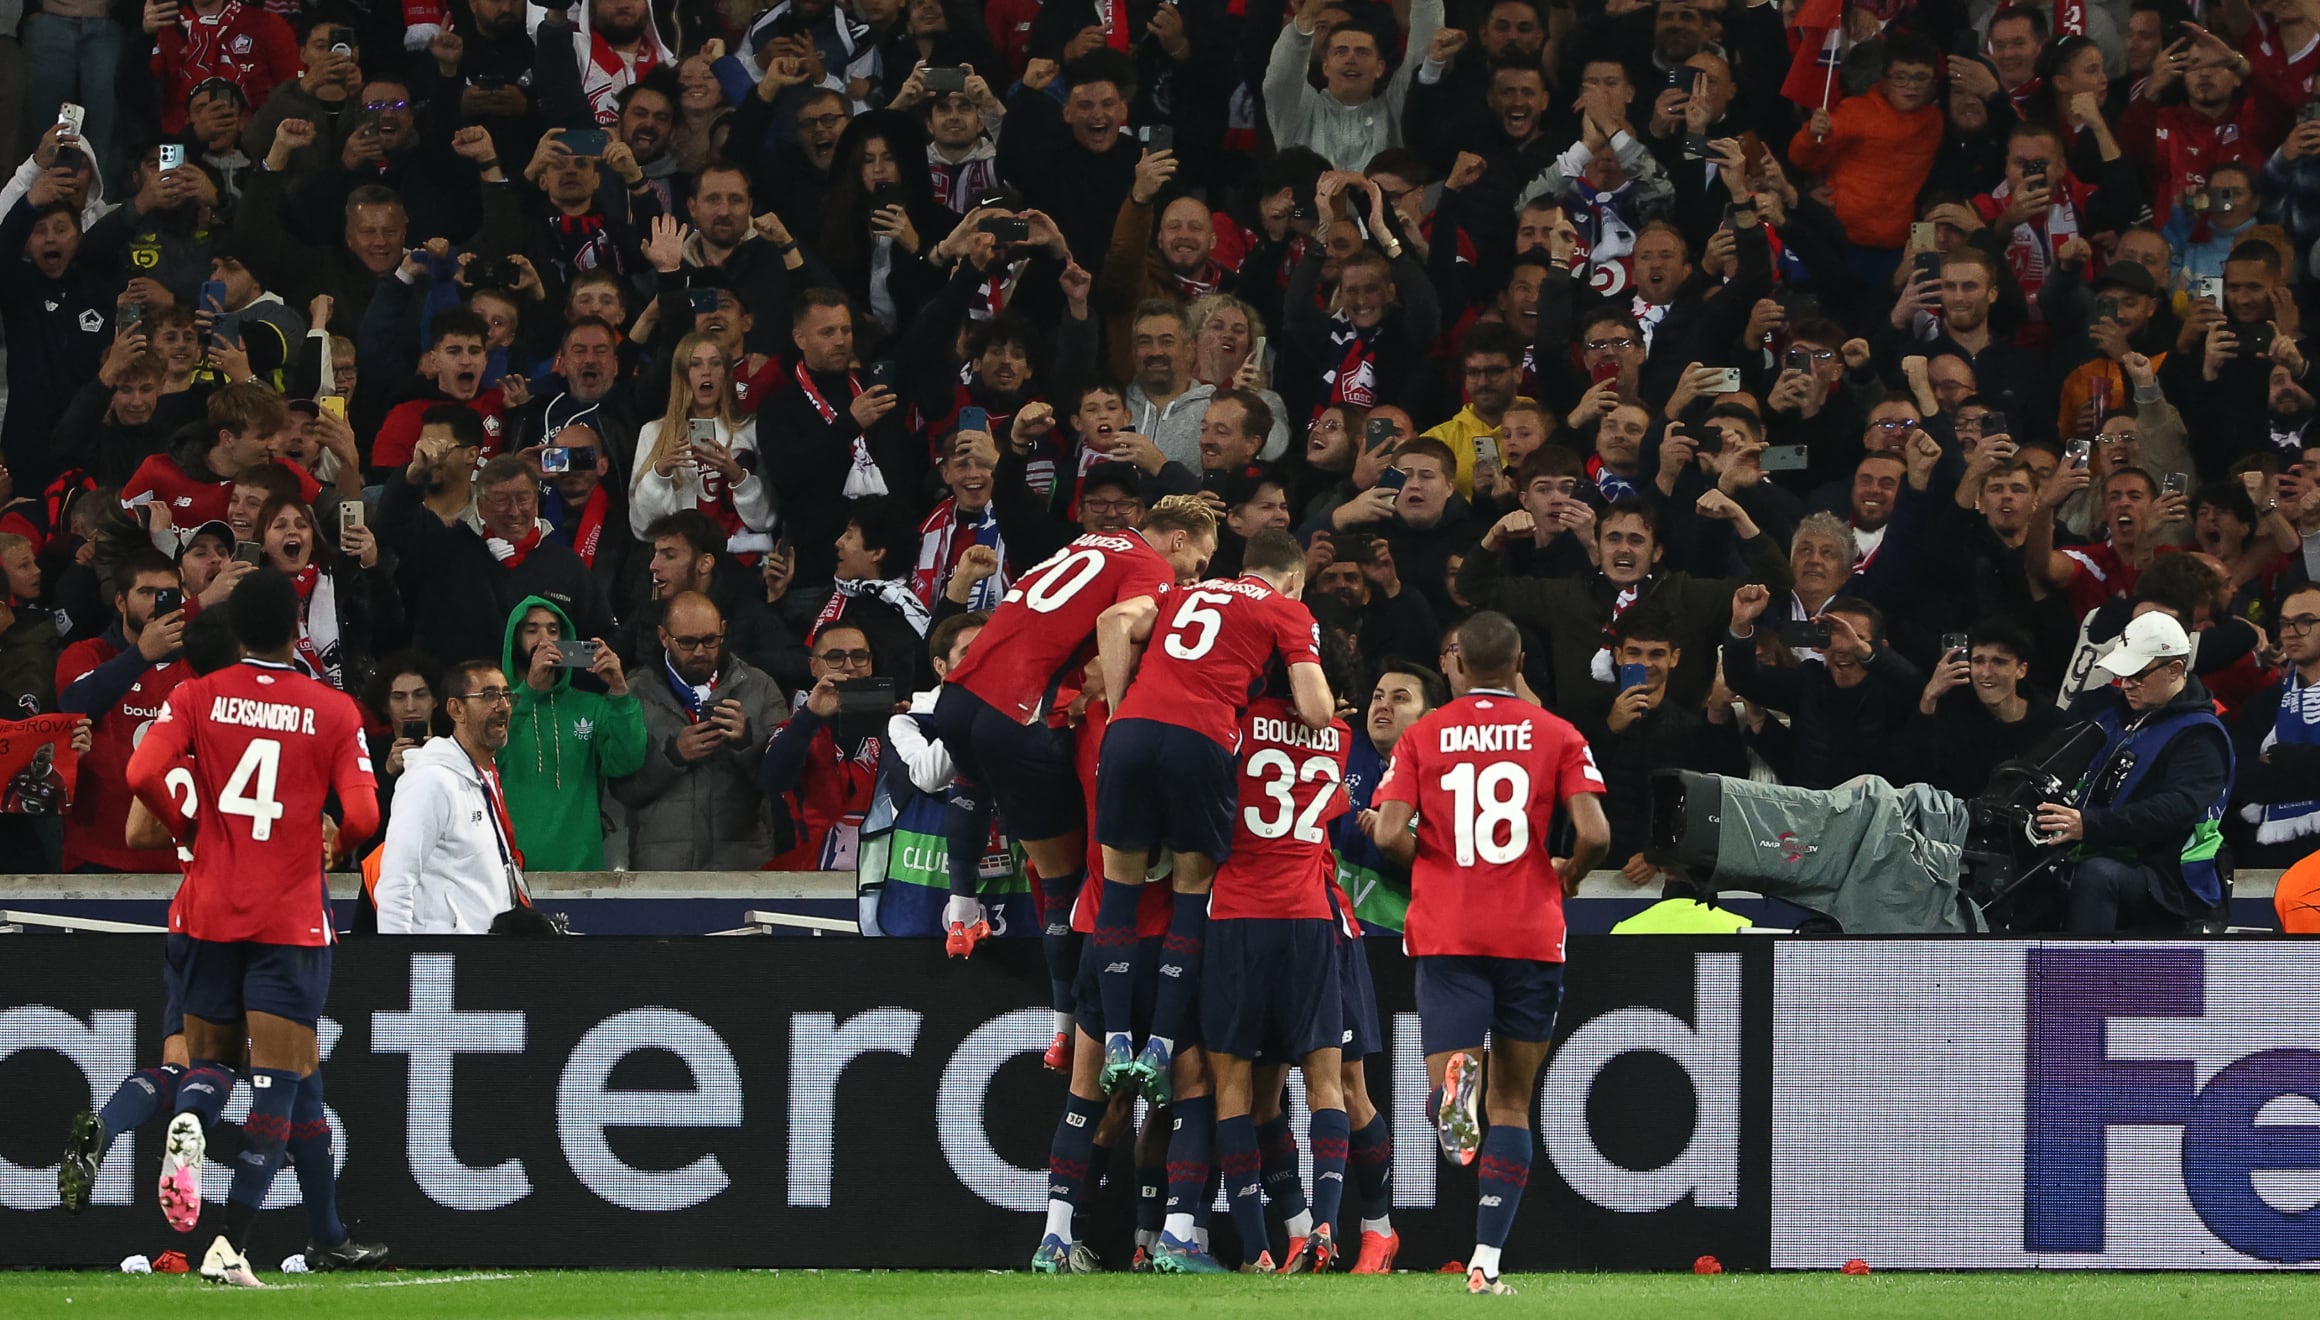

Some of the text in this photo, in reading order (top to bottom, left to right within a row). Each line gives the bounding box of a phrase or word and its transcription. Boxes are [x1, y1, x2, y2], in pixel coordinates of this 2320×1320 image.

[1164, 590, 1232, 661] 5
[210, 696, 316, 735] ALEXSANDRO R.
[1253, 717, 1339, 752] BOUADDI
[1440, 719, 1533, 753] DIAKITÉ
[218, 737, 284, 842] 4
[1244, 748, 1340, 844] 32
[1440, 761, 1530, 867] 18
[2023, 947, 2320, 1264] Fe
